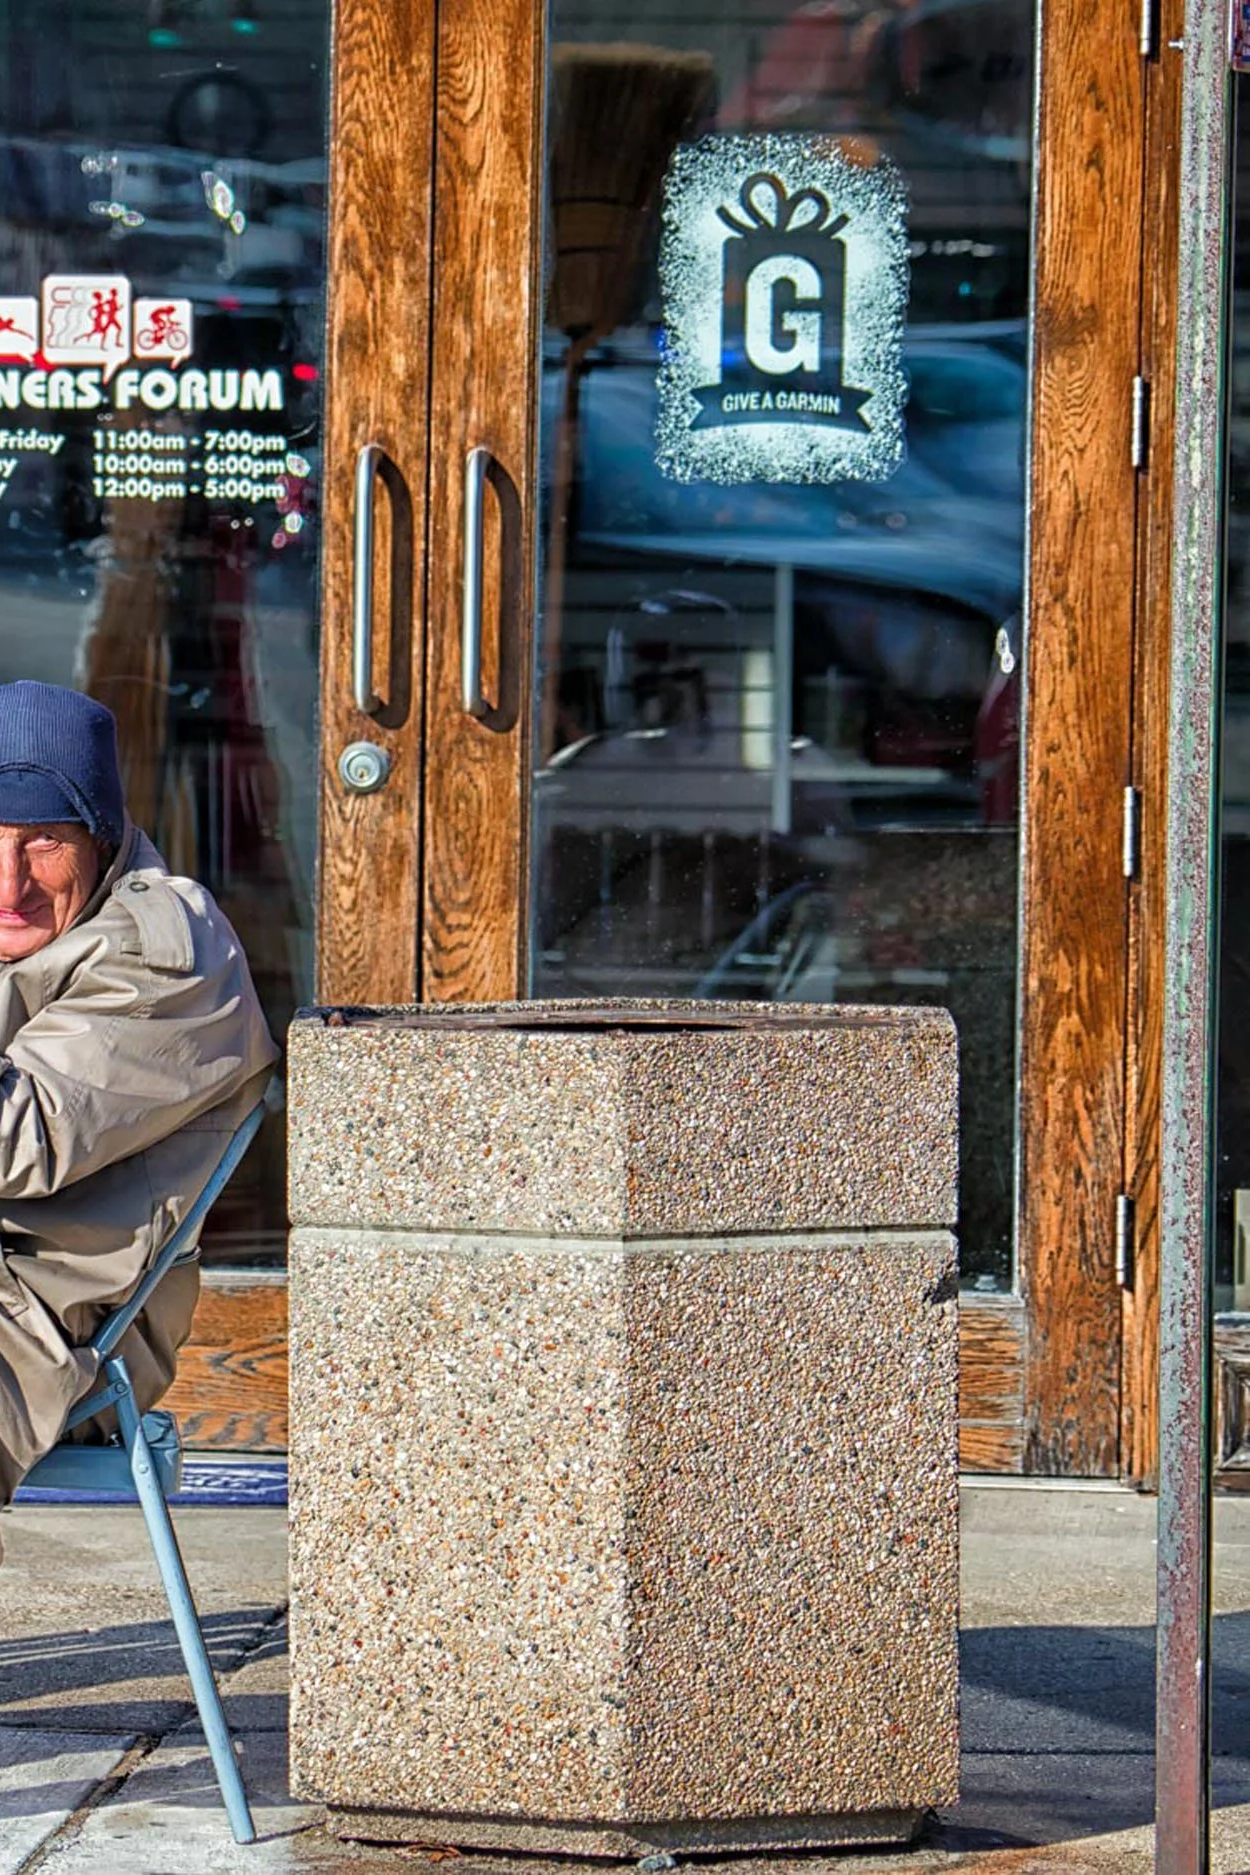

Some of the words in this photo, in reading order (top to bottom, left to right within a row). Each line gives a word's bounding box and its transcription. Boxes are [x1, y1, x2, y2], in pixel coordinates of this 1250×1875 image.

[745, 255, 822, 375] G
[115, 369, 284, 410] FORUM
[722, 391, 760, 413] GIVE
[761, 390, 774, 410] A
[775, 390, 840, 415] GARMIN
[93, 430, 186, 450] 11:00am
[205, 430, 286, 456] 7:00pm
[93, 453, 186, 474] 10:00am
[204, 453, 286, 479] 6:00pm
[92, 477, 186, 503] 12:00pm
[204, 477, 286, 504] 5:00pm
